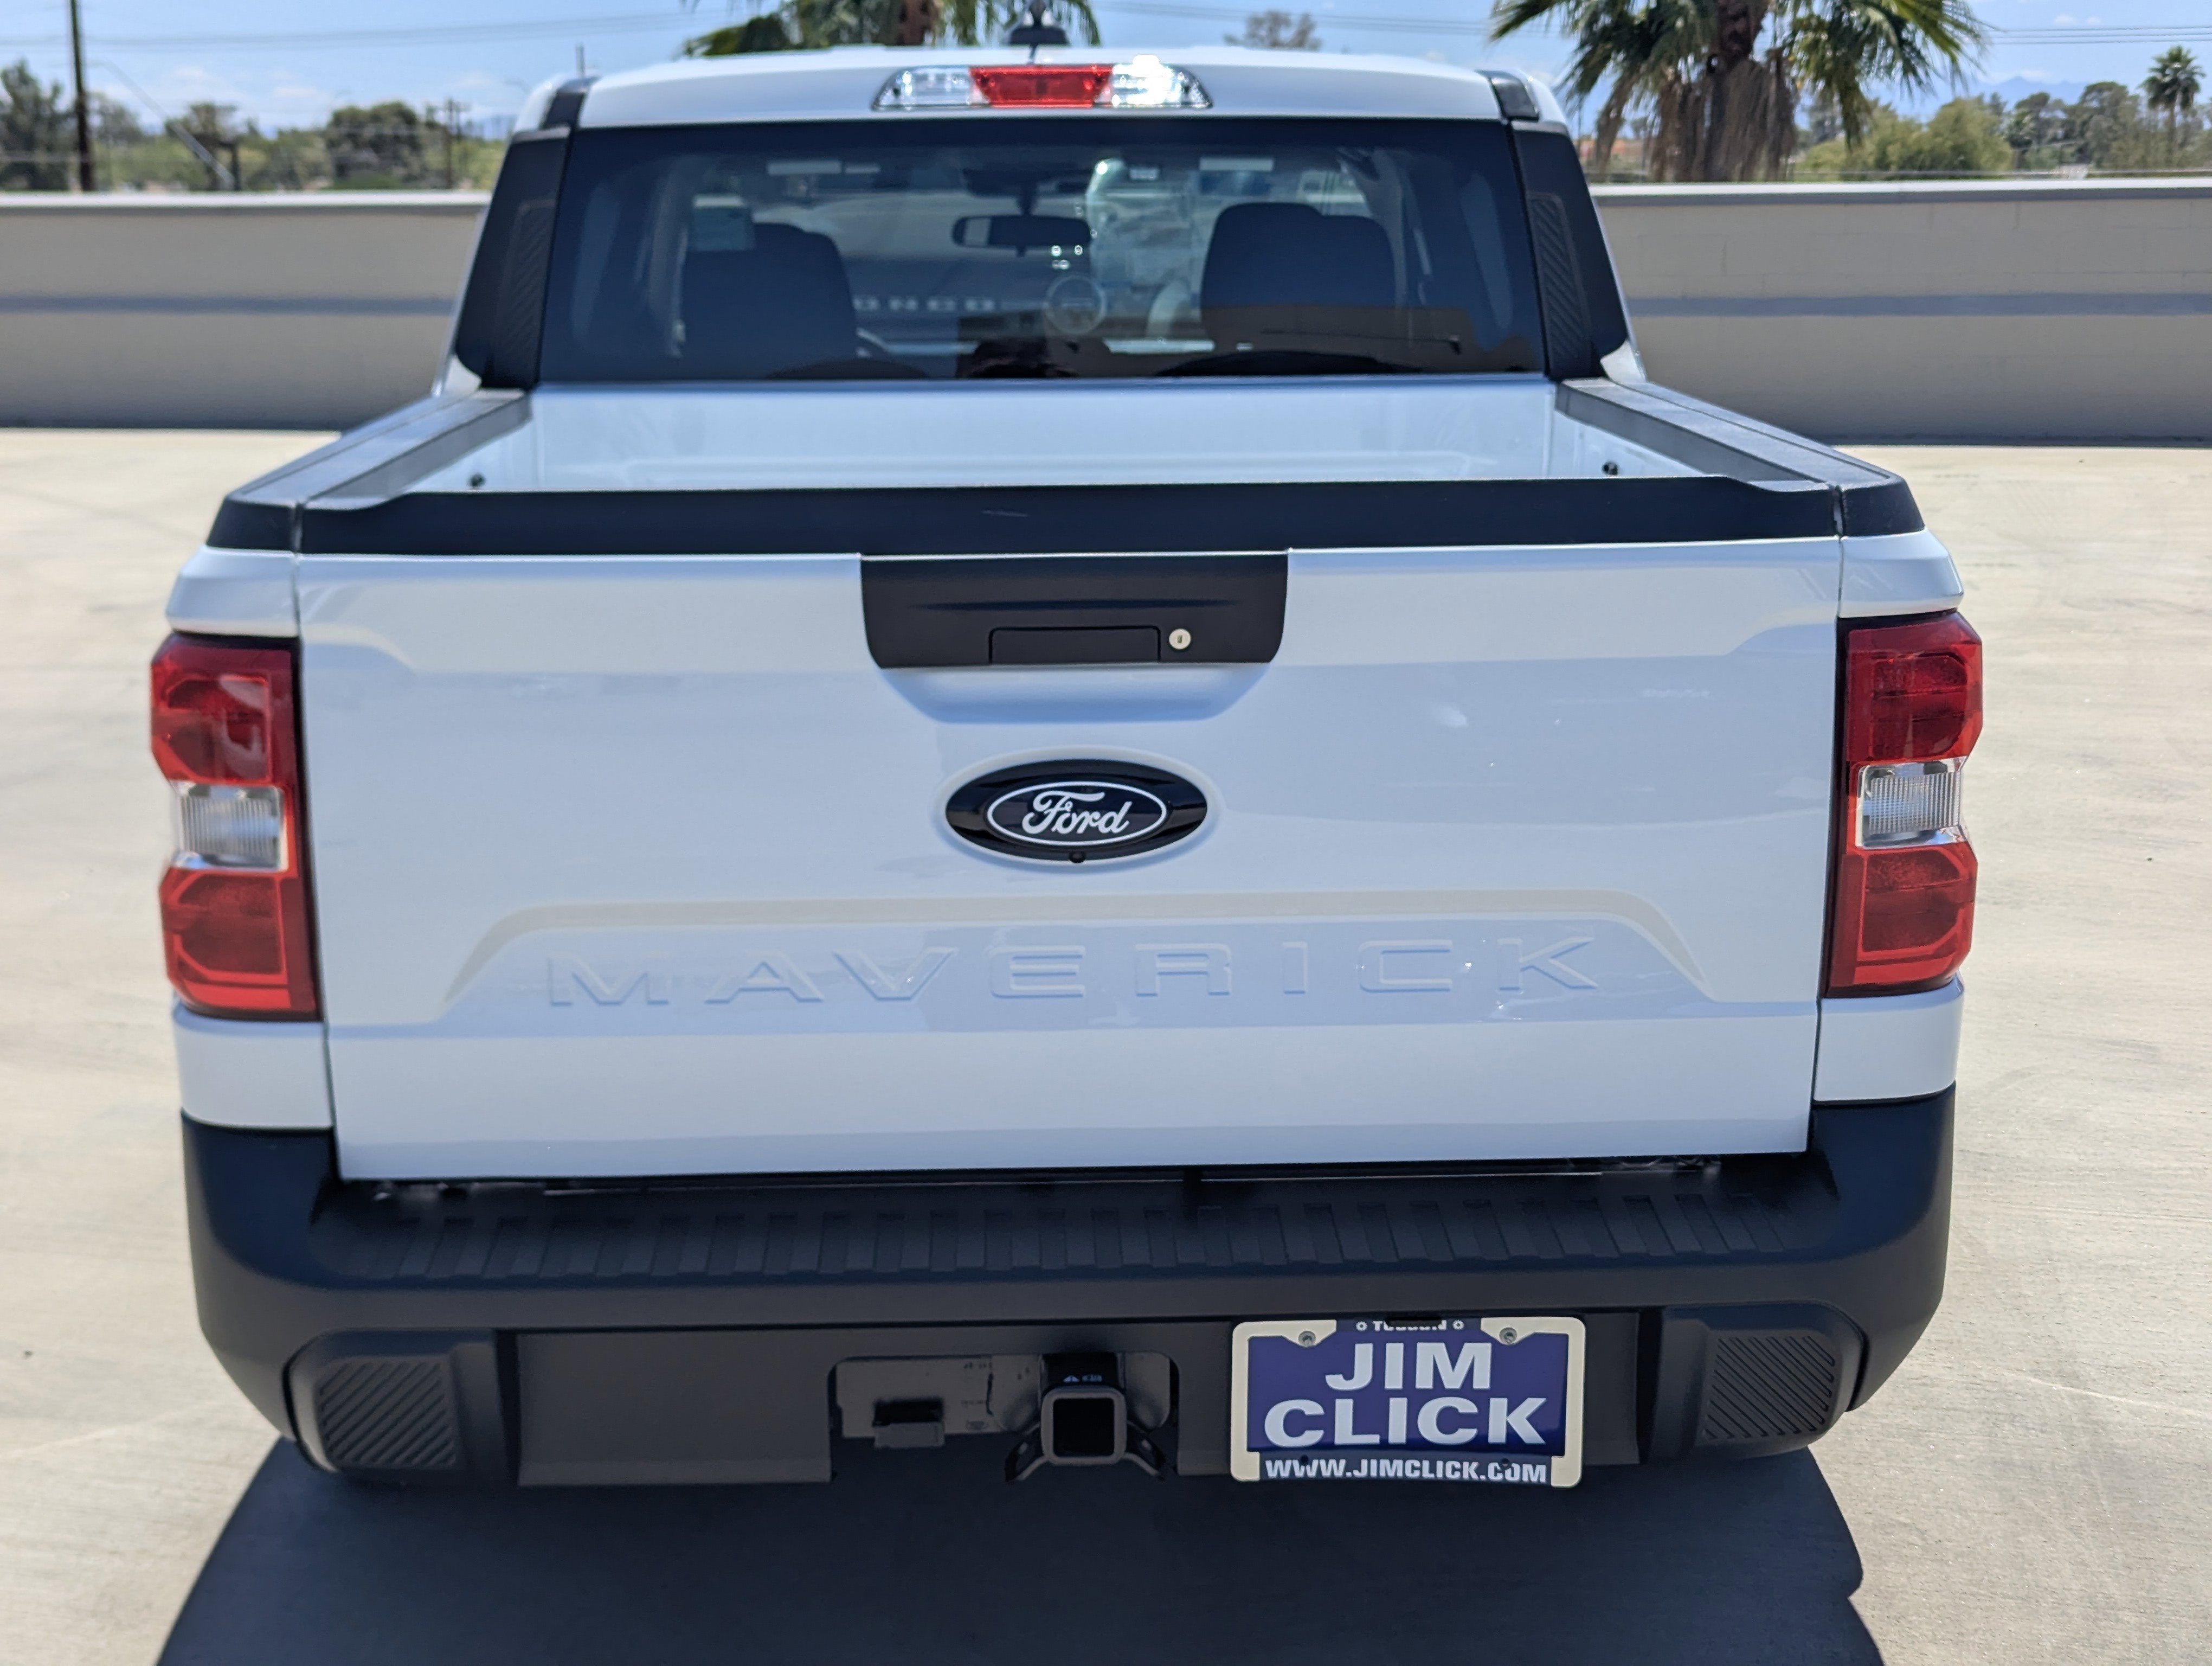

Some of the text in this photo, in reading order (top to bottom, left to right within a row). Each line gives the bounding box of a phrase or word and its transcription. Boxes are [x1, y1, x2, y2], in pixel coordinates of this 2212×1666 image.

[1022, 790, 1133, 835] Ford
[547, 937, 1598, 1006] MAVERICK
[1325, 1342, 1491, 1391] JIM
[1264, 1396, 1547, 1448] CLICK
[1265, 1458, 1547, 1483] WWW.JIMCLICK.COM
